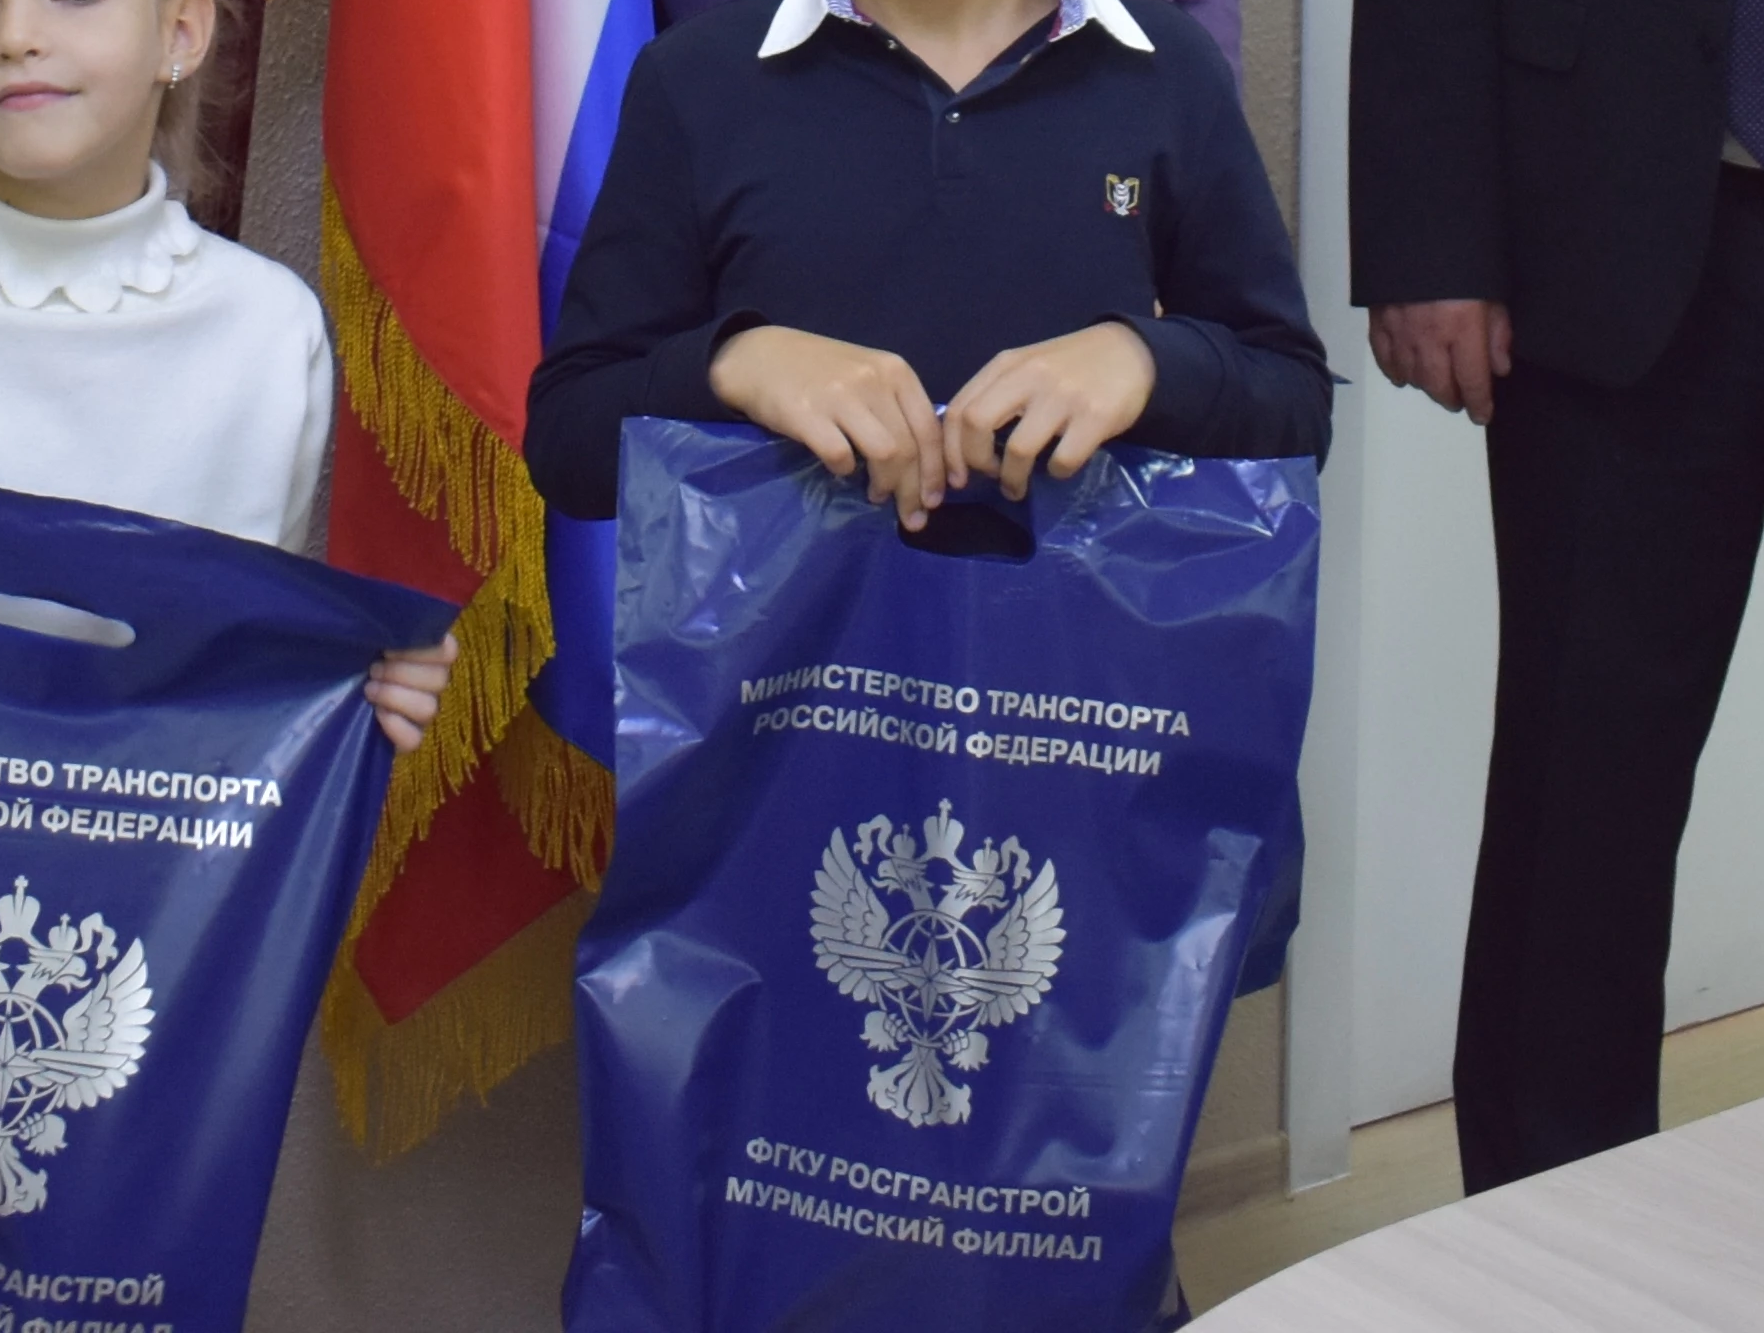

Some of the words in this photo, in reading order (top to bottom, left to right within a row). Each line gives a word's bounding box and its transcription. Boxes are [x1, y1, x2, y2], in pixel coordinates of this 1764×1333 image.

[741, 664, 978, 714] МИНИСТЕРСТВО
[986, 689, 1190, 736] ТРАНСПОРТА
[753, 704, 958, 754] РОССИЙСКОЙ
[965, 731, 1162, 775] ФЕДЕРАЦИИ
[63, 762, 283, 807] ТРАНСПОРТА
[41, 806, 253, 850] ФЕДЕРАЦИИ
[746, 1136, 827, 1177] ФГКУ
[829, 1157, 1091, 1219] РОСГРАНСТРОЙ
[725, 1176, 945, 1248] МУРМАНСКИЙ
[953, 1227, 1102, 1262] ФИЛИАЛ
